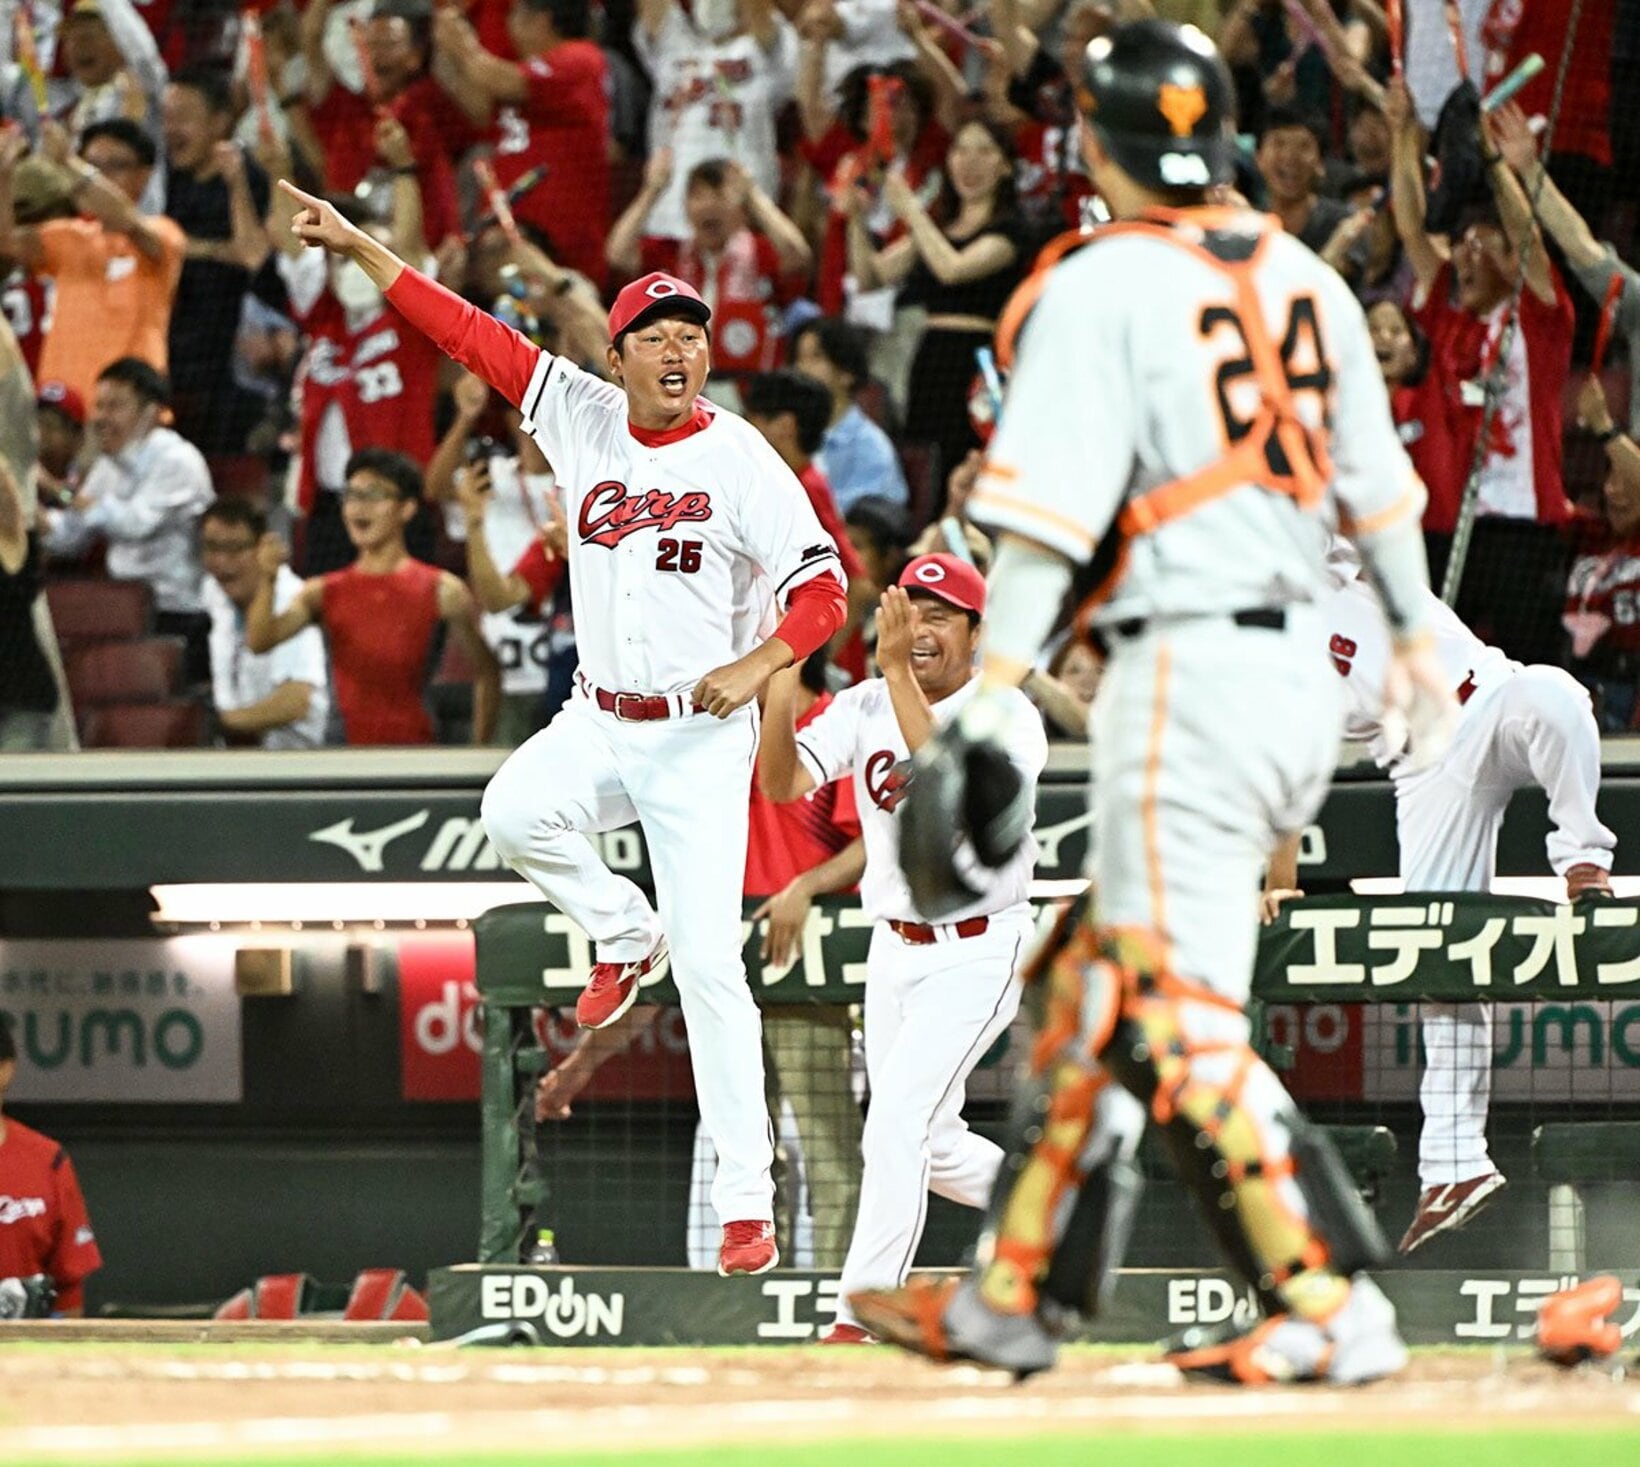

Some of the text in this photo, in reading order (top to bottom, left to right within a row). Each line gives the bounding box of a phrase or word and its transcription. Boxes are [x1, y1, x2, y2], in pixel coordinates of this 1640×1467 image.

[1199, 296, 1333, 446] 24
[578, 480, 712, 549] Carp
[656, 538, 703, 573] 25
[0, 1007, 204, 1069] umo
